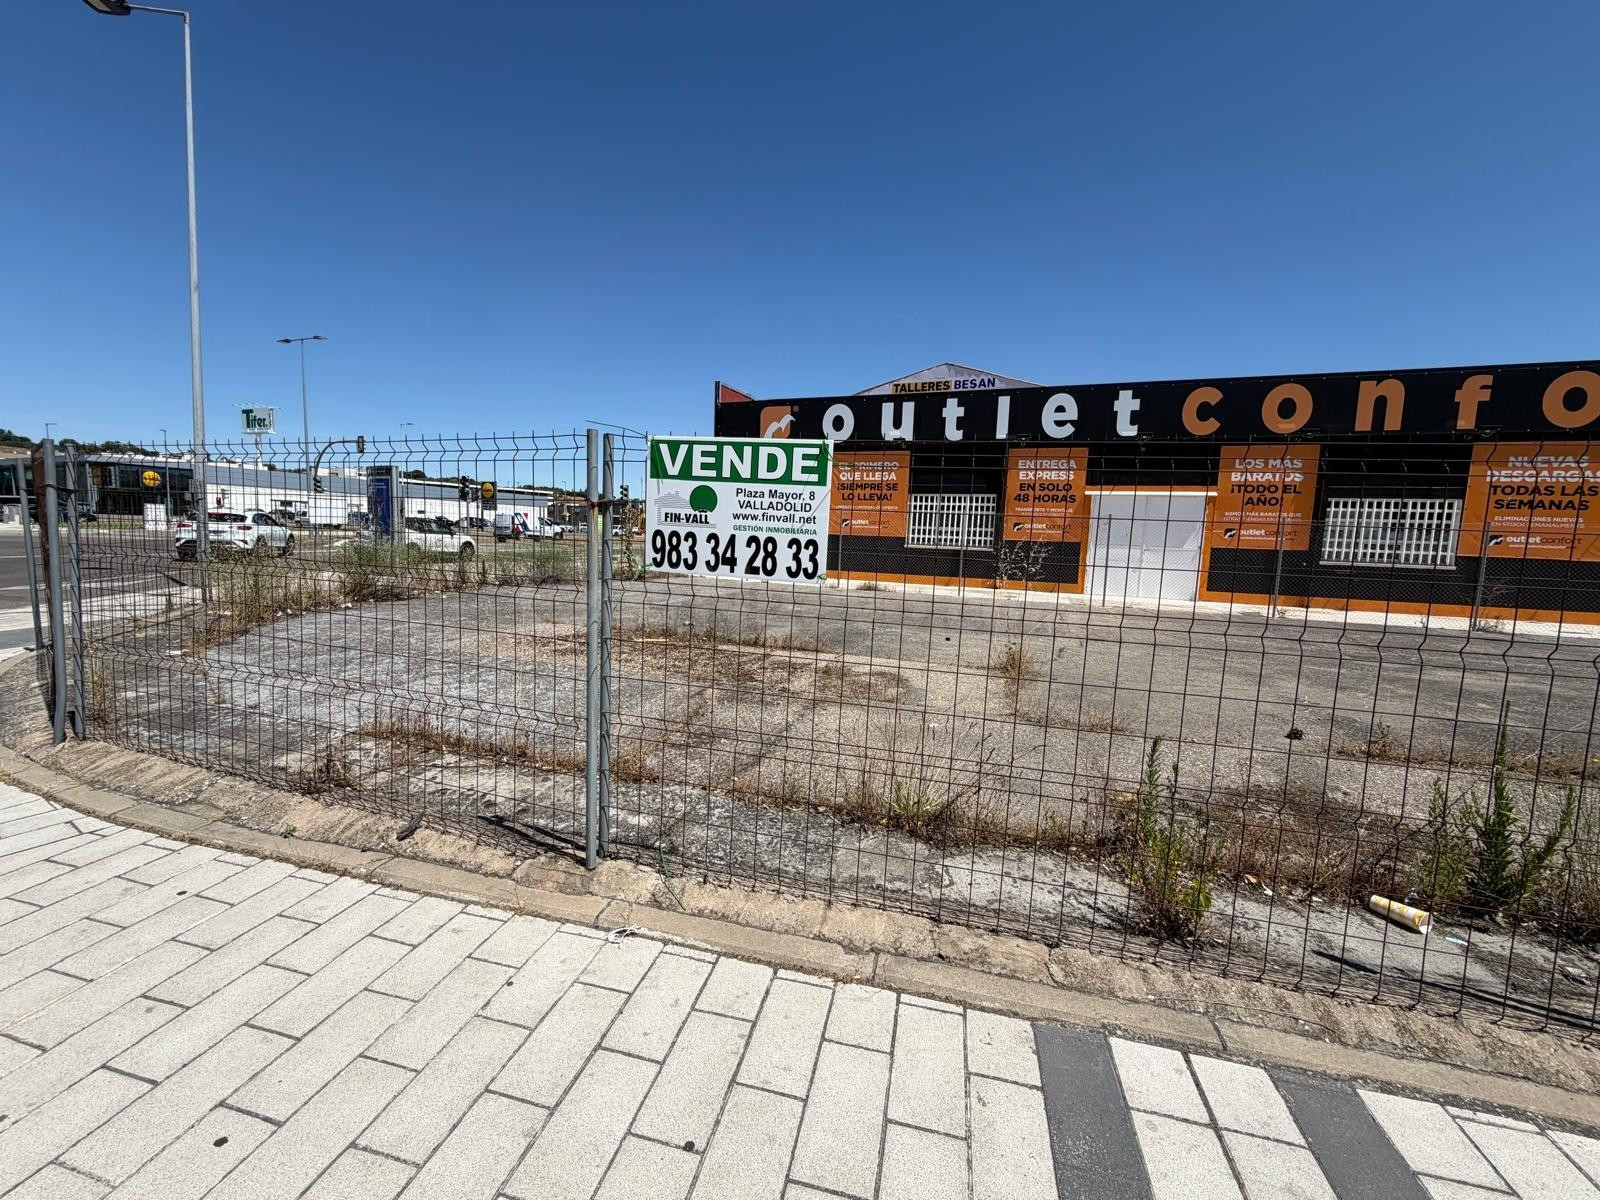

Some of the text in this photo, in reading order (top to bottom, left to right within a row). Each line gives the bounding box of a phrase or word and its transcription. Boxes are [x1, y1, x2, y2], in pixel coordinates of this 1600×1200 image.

[893, 378, 996, 394] TALLERES BESAN
[659, 444, 820, 482] VENDE
[1018, 460, 1077, 469] ENTREGA
[1235, 456, 1303, 469] LOS MÁS
[1508, 456, 1590, 468] NUEVAS
[840, 472, 897, 481] QUE LLEGA
[1019, 471, 1075, 480] EXPRESS
[1231, 472, 1304, 482] BARATOS
[837, 482, 899, 491] ¡SIEMPRE SE
[1019, 483, 1073, 492] EN SOLO
[1283, 484, 1302, 494] EL
[1491, 485, 1599, 497] TODAS LAS
[736, 488, 815, 502] Plaza Mayor, 8
[841, 492, 892, 501] LO LLEVA!
[1014, 493, 1076, 503] 48 HORAS
[738, 499, 812, 512] VALLADOLID
[1493, 499, 1590, 511] SEMANAS
[664, 512, 710, 525] FIN-VALL
[732, 511, 817, 525] www.finvall.net
[651, 529, 819, 580] 983 34 28 33
